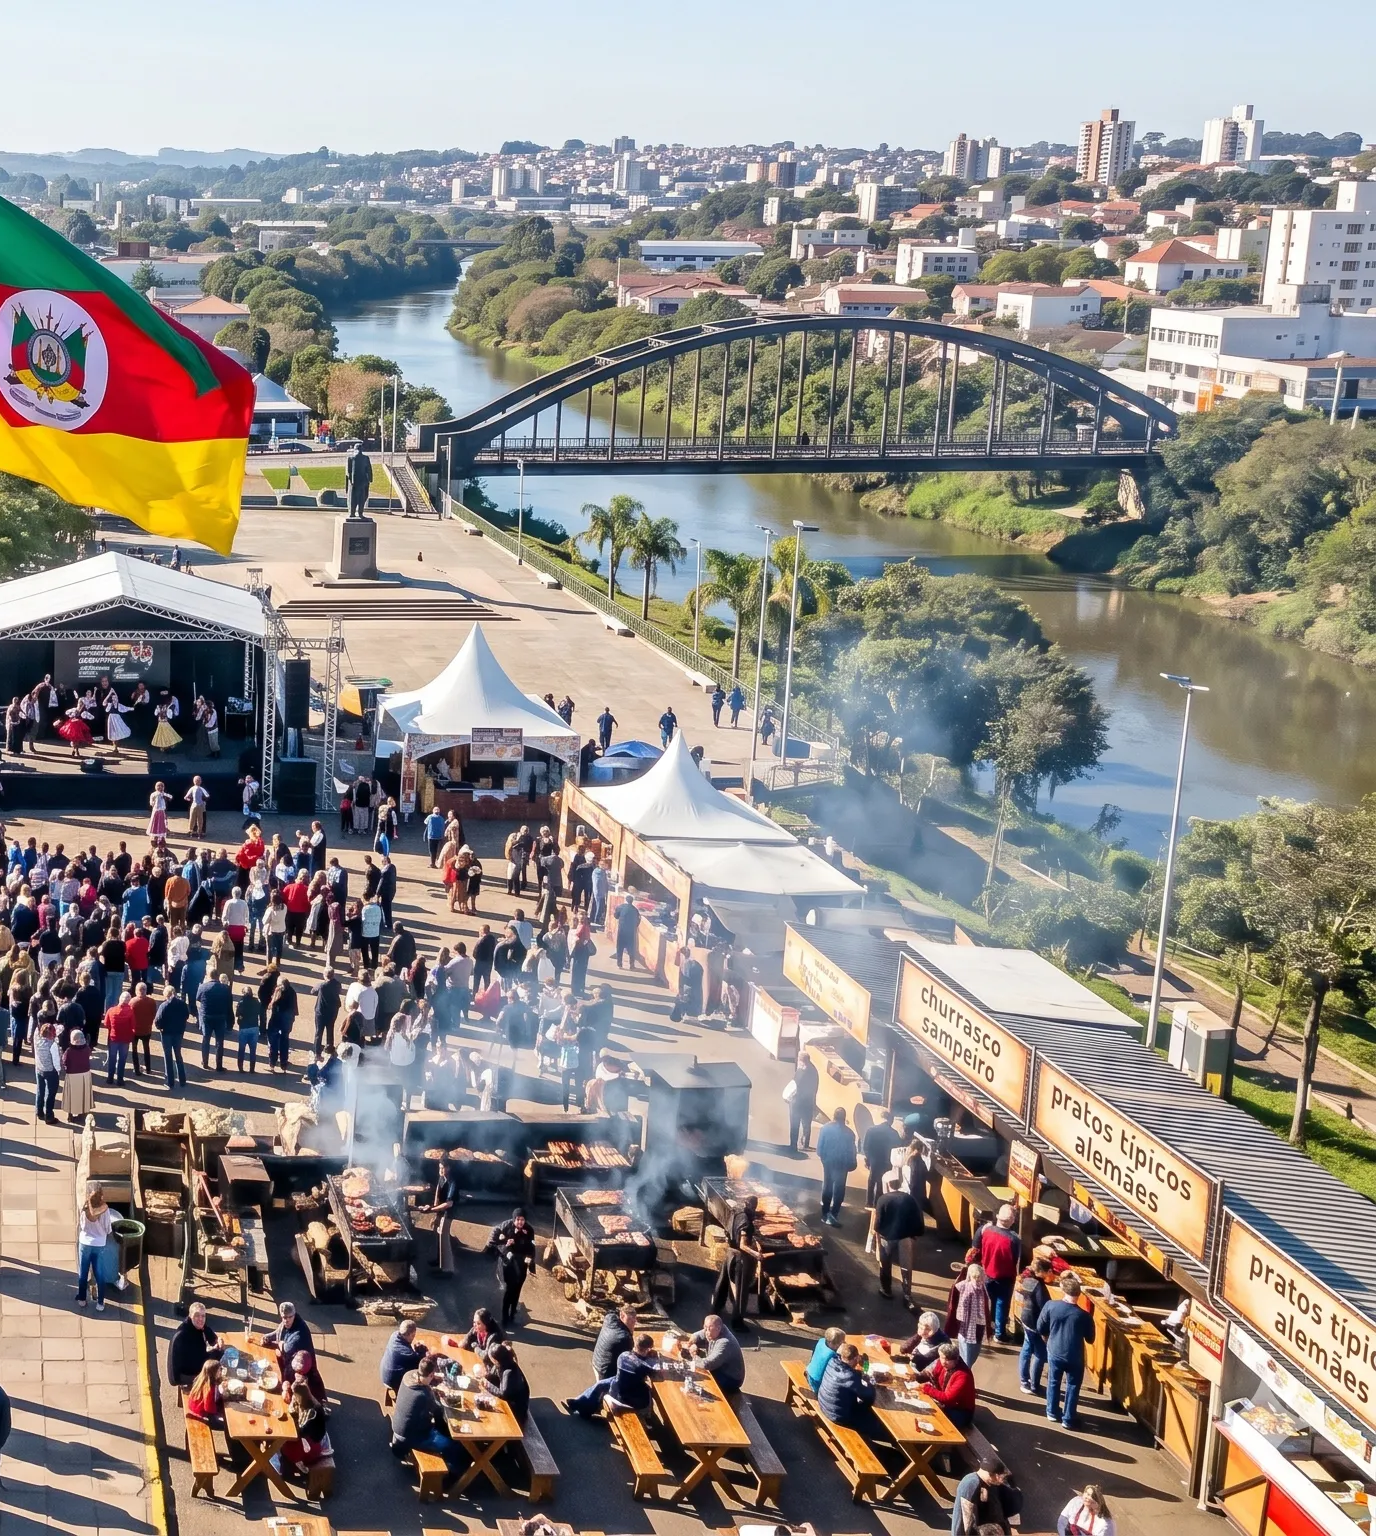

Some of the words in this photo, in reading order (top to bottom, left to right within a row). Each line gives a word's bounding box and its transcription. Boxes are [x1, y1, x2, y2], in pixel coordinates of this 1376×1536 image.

[921, 985, 1001, 1057] churrasco
[922, 1017, 994, 1083] sampeiro
[1051, 1084, 1113, 1143] pratos
[1075, 1136, 1159, 1213] alemães
[1249, 1254, 1322, 1325] pratos
[1275, 1312, 1369, 1404] alemães
